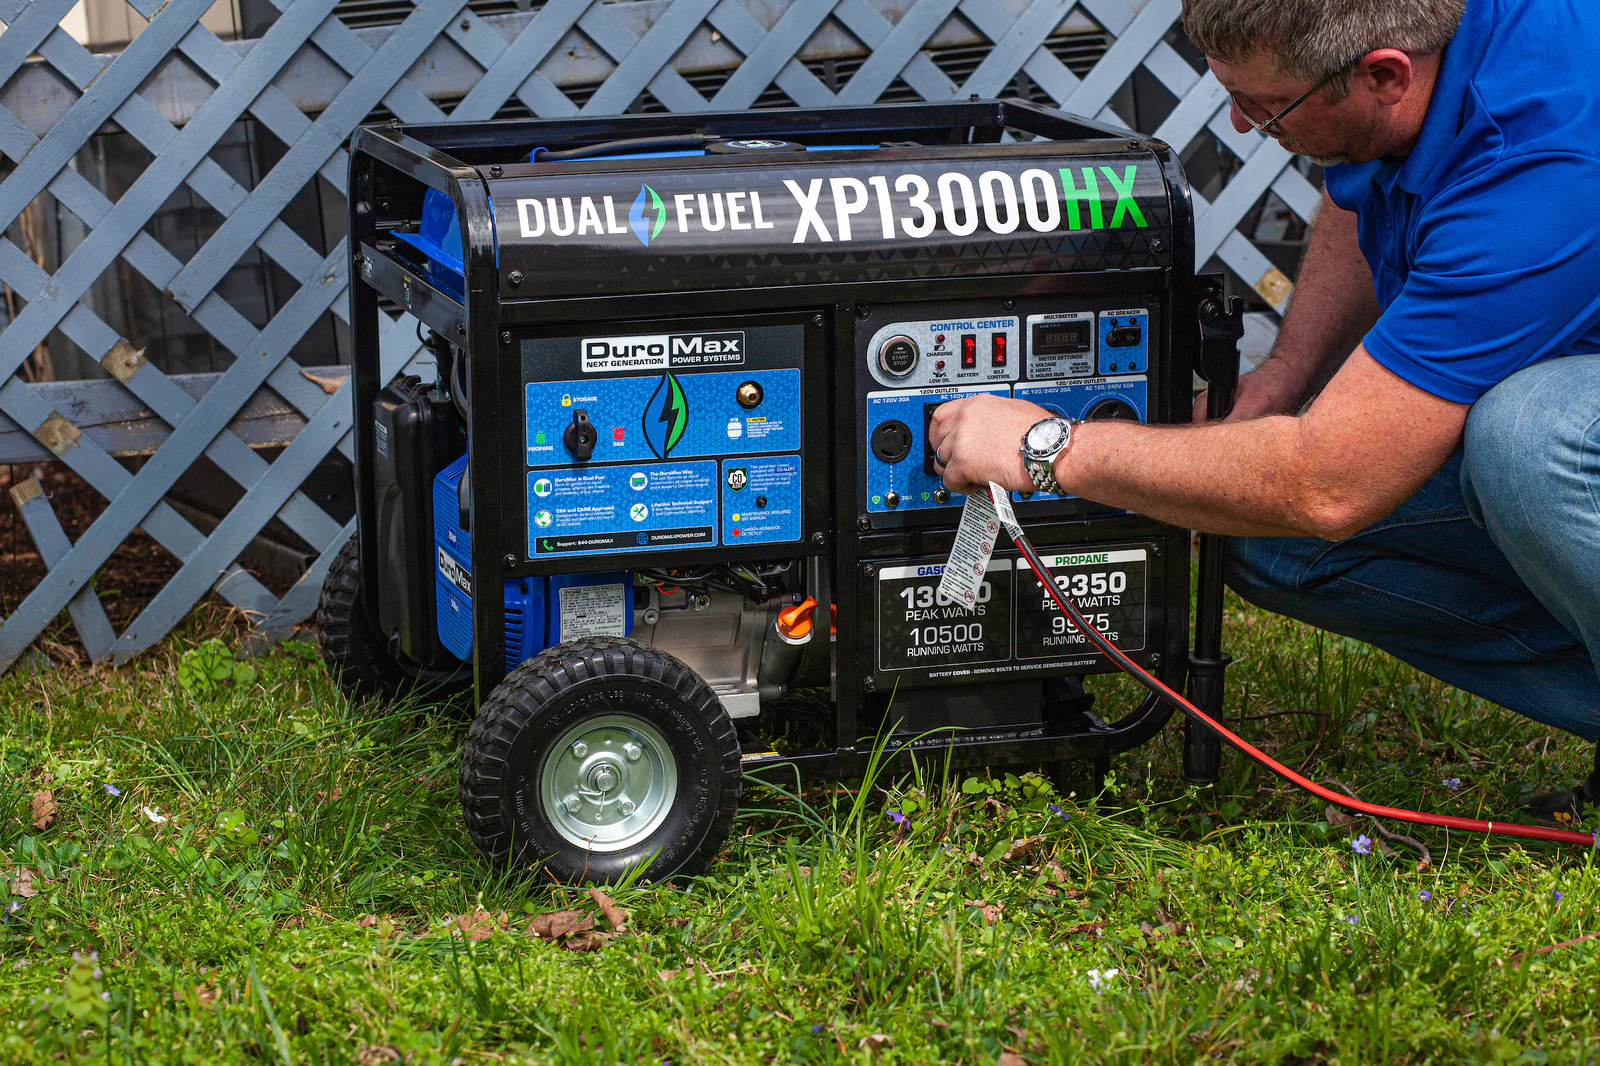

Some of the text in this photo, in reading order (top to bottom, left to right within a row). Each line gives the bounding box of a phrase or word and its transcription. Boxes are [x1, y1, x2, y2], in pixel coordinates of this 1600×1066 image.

[516, 165, 1148, 244] DUAL FUEL XP13000HX
[930, 319, 1014, 332] CONTROL CENTER
[611, 358, 664, 366] GENERATION
[703, 354, 740, 362] SYSTEMS
[732, 473, 742, 484] CO
[1055, 554, 1108, 566] PROPANE
[1042, 597, 1074, 611] PE
[1078, 594, 1120, 608] WATTS
[906, 605, 986, 622] PEAK WATTS
[910, 623, 982, 646] 10500
[1043, 634, 1086, 648] RUNNING
[907, 642, 984, 657] RUNNING WATTS
